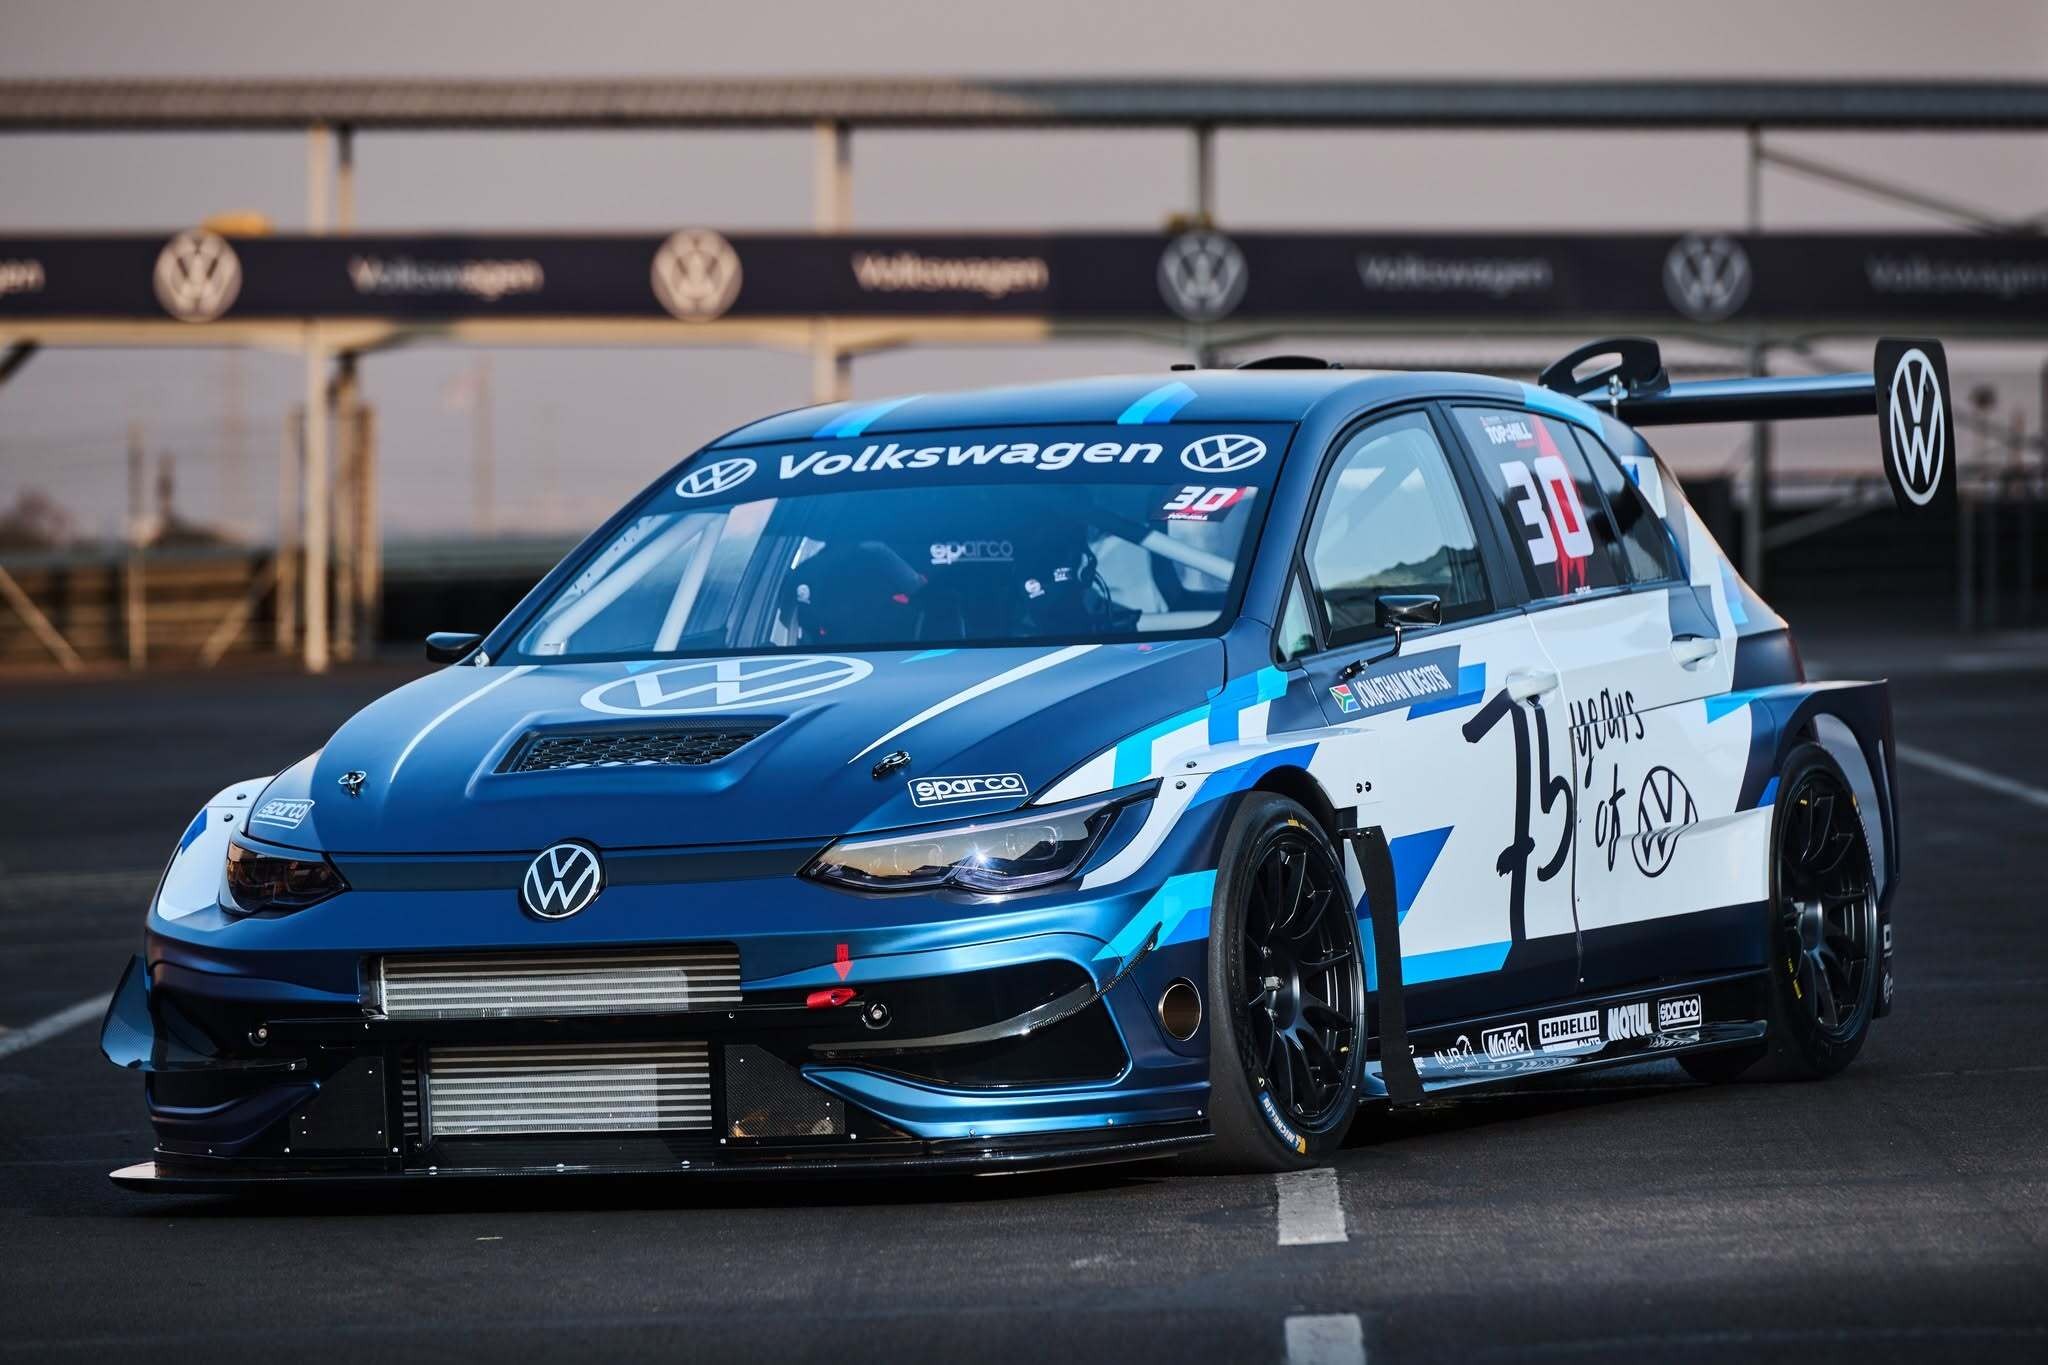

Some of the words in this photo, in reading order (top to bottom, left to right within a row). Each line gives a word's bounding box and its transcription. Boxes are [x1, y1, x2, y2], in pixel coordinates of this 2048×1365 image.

[1890, 348, 1945, 505] VW
[777, 439, 1163, 480] Volkswagen
[1180, 434, 1267, 473] VW
[675, 457, 757, 498] VW
[1163, 486, 1237, 511] 30
[1500, 455, 1594, 566] 30
[1354, 673, 1411, 708] JONATHAN
[1569, 688, 1645, 789] years
[916, 775, 1020, 802] sparco
[1595, 763, 1626, 872] of
[524, 843, 600, 918] VW
[1541, 1015, 1597, 1039] CARELLO
[1608, 1002, 1653, 1041] MOTUL
[1660, 999, 1699, 1026] sparco
[1488, 1029, 1525, 1058] MoTeC
